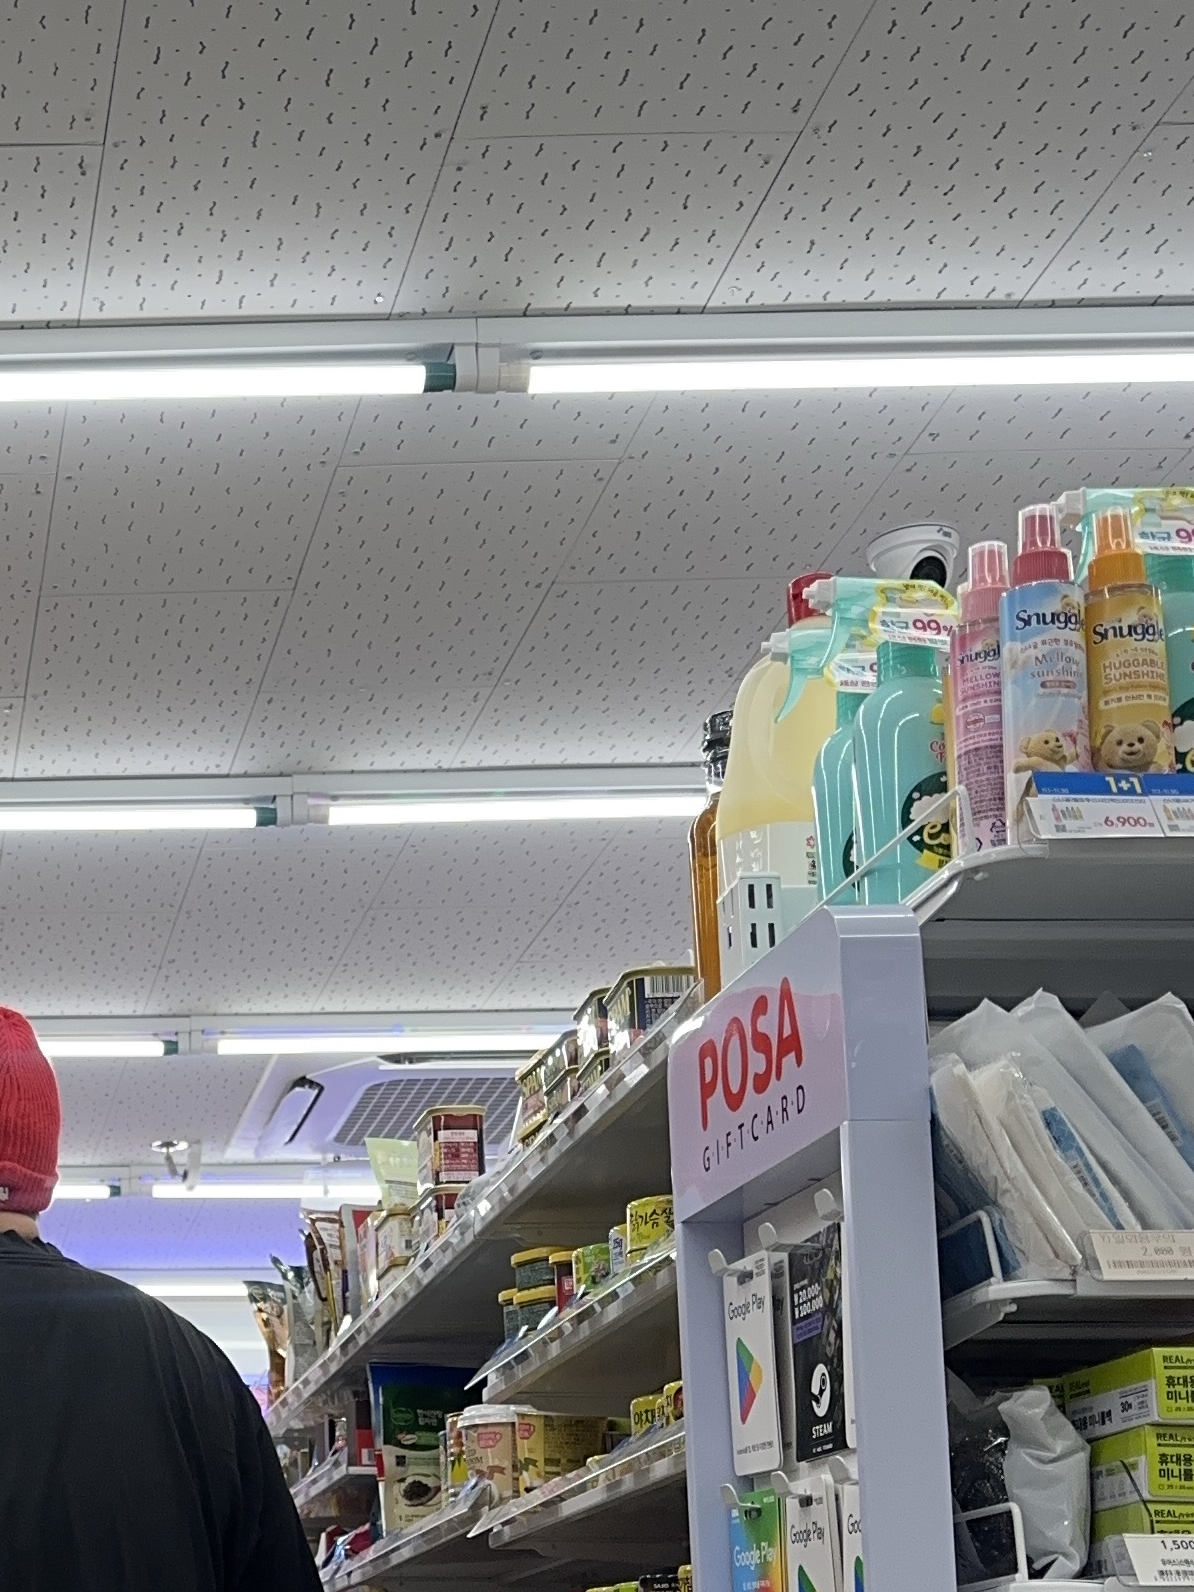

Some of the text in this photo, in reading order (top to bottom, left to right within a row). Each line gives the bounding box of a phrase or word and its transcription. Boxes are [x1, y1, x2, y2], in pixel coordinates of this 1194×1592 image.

[912, 619, 953, 636] 99%
[1092, 622, 1165, 646] Snuggle
[1034, 651, 1080, 667] Mellow
[1102, 659, 1165, 673] HUGGABLE
[1105, 777, 1143, 794] 1+1
[699, 976, 803, 1132] POSA
[728, 1292, 765, 1321] Google Play
[812, 1421, 833, 1439] STEAM
[1158, 1453, 1194, 1468] 휴대용
[790, 1520, 825, 1548] Google Play
[734, 1541, 777, 1570] Google Play
